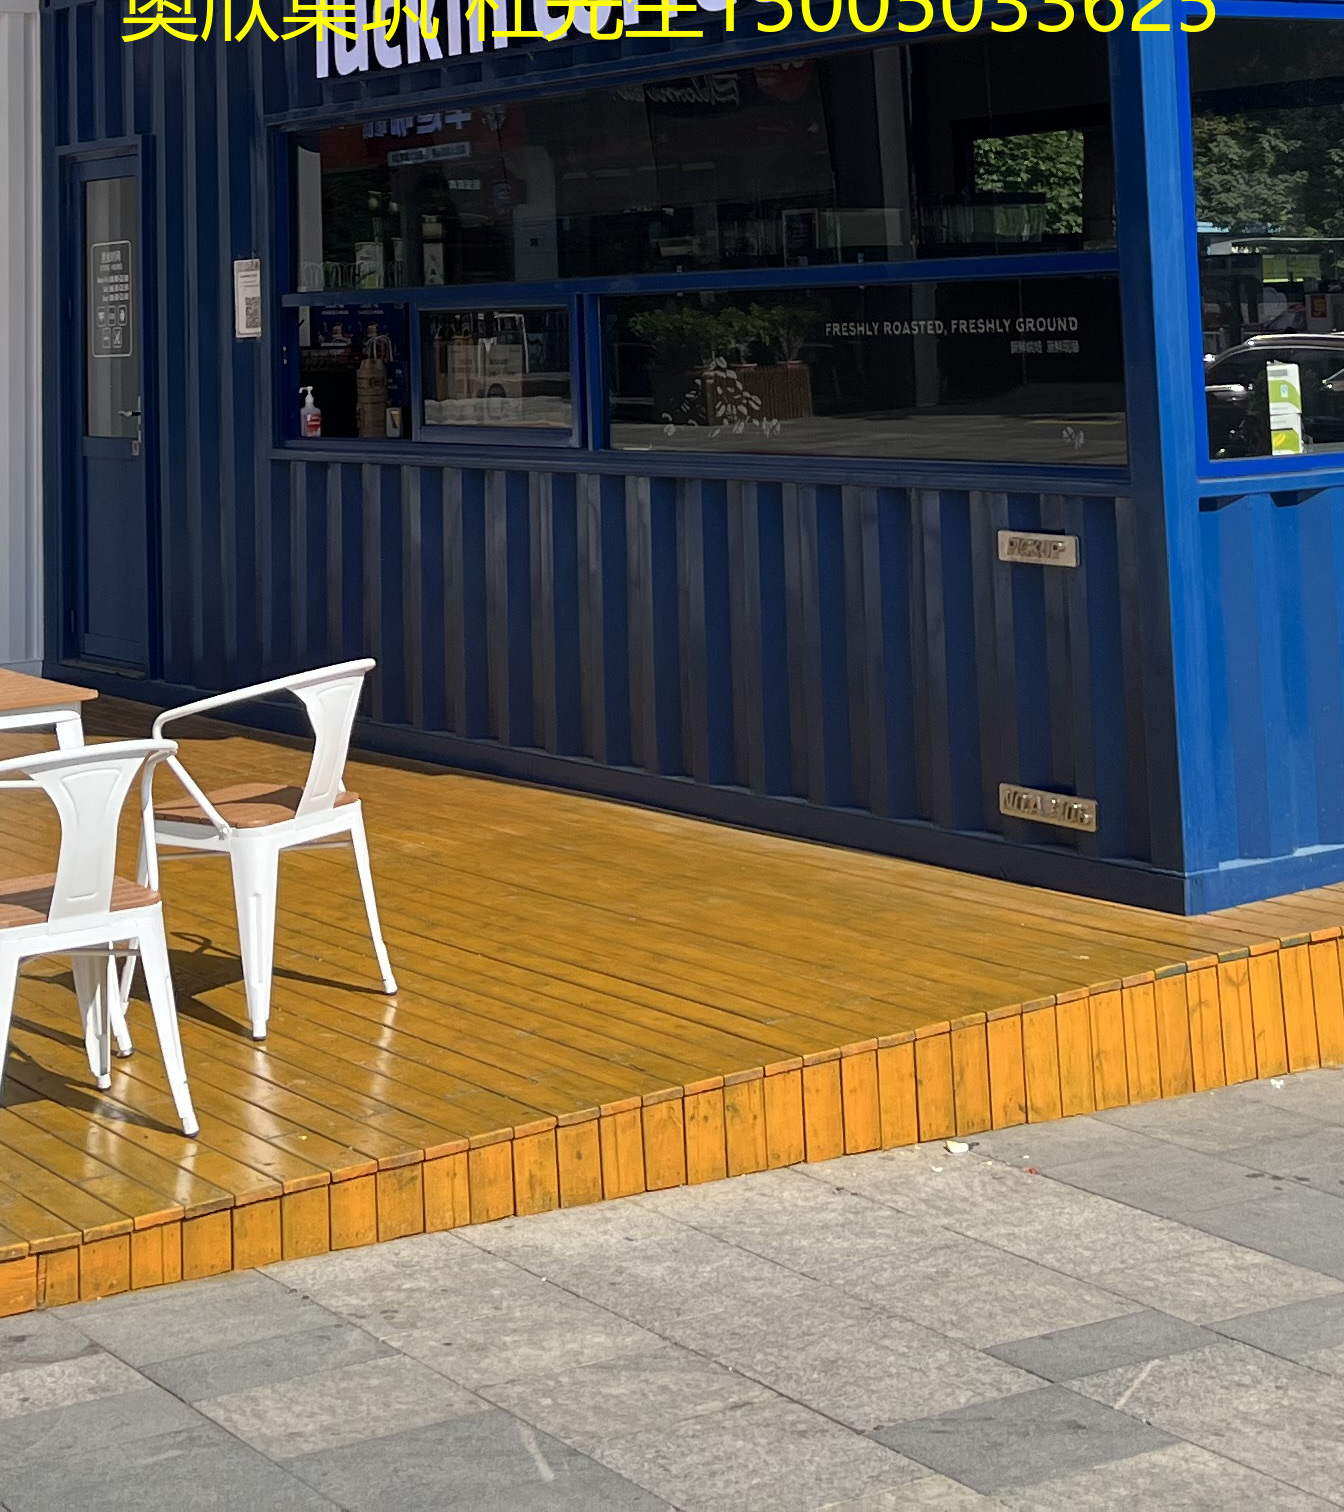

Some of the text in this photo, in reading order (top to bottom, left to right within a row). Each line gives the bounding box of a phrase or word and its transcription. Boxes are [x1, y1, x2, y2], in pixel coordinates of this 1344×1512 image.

[825, 316, 1079, 336] FRESHLY ROASTED, FRESHLY GROUND
